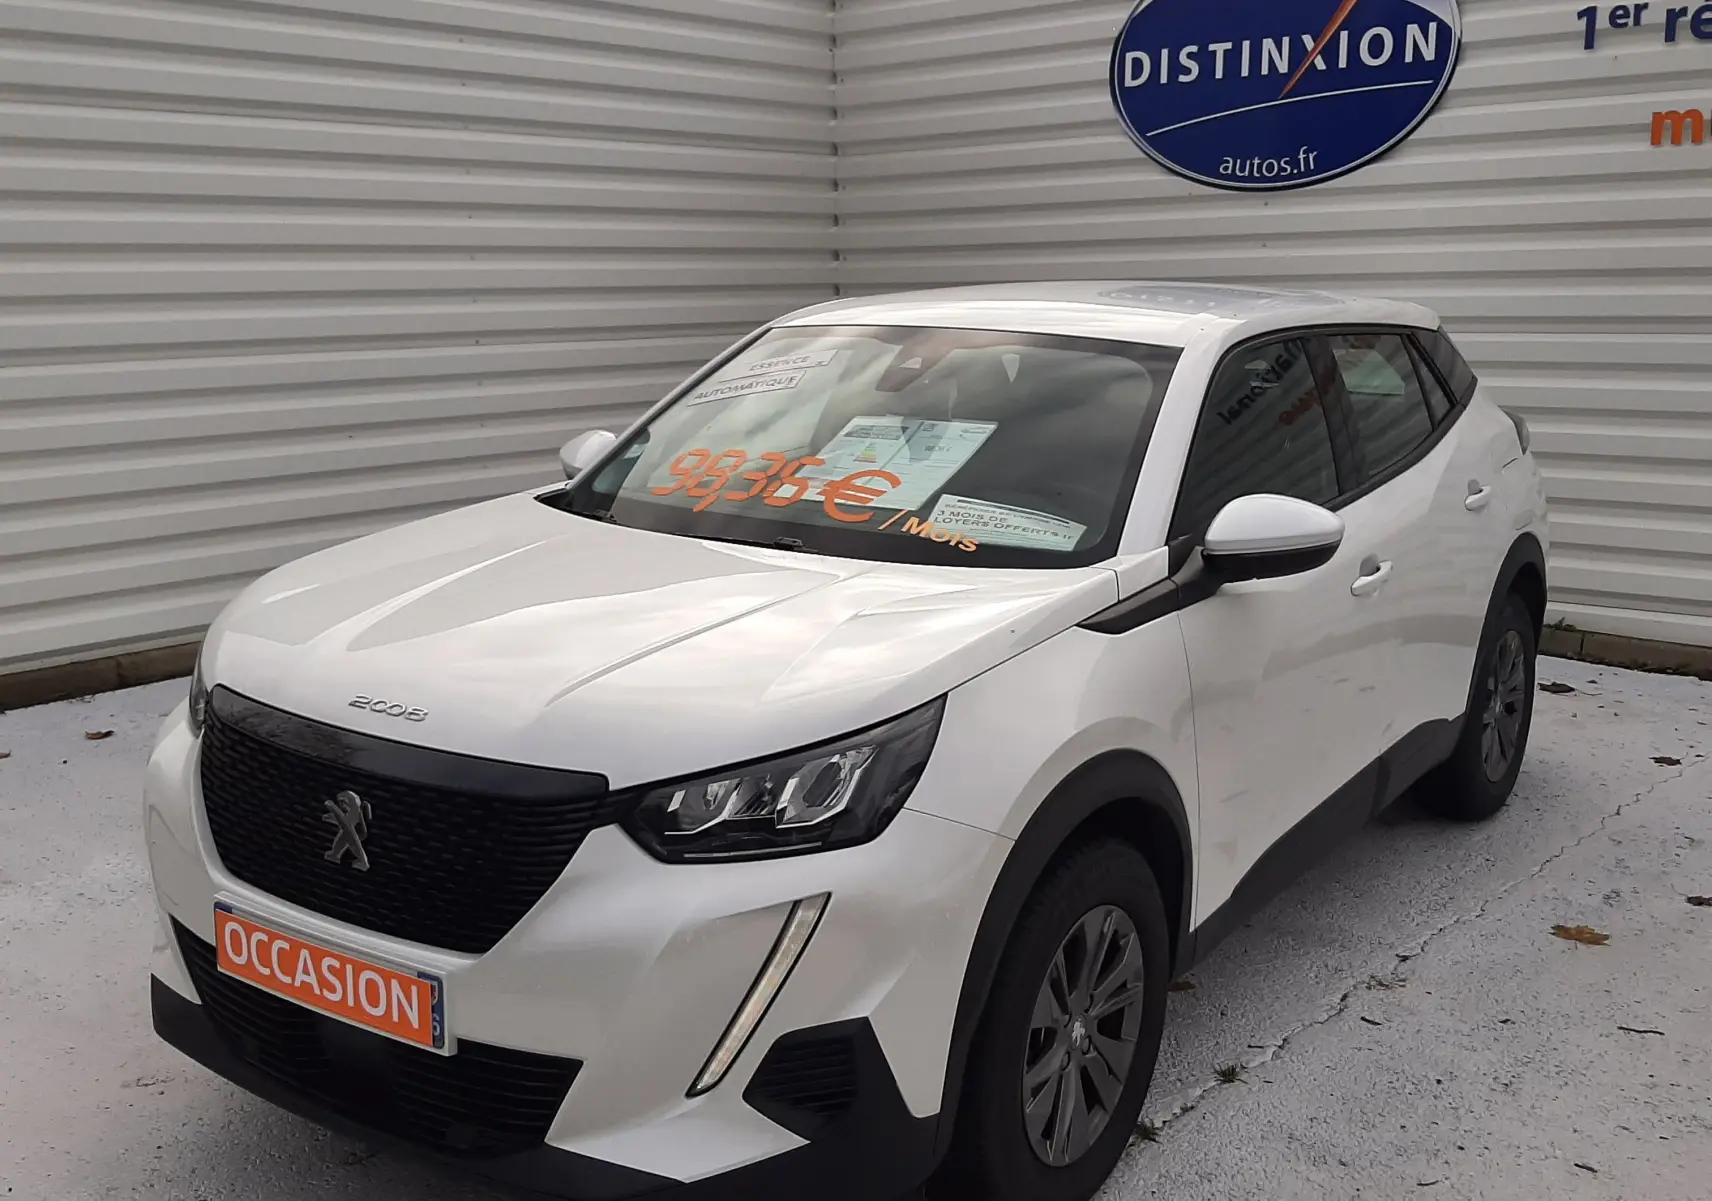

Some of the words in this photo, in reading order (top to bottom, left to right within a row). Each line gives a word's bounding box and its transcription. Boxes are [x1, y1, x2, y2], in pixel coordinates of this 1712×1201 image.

[1122, 21, 1438, 88] DISTINXION
[1650, 108, 1712, 146] m
[1218, 146, 1318, 178] autos.fr
[693, 375, 798, 401] AUTOMATIQUE
[651, 447, 826, 513] 98,36
[816, 469, 902, 523] €
[934, 516, 990, 528] LOYERS
[993, 522, 1060, 537] OFFERTS
[949, 511, 985, 520] MOIS
[989, 515, 1008, 523] DE
[348, 693, 430, 722] 2008
[222, 921, 421, 1031] OCCASION
